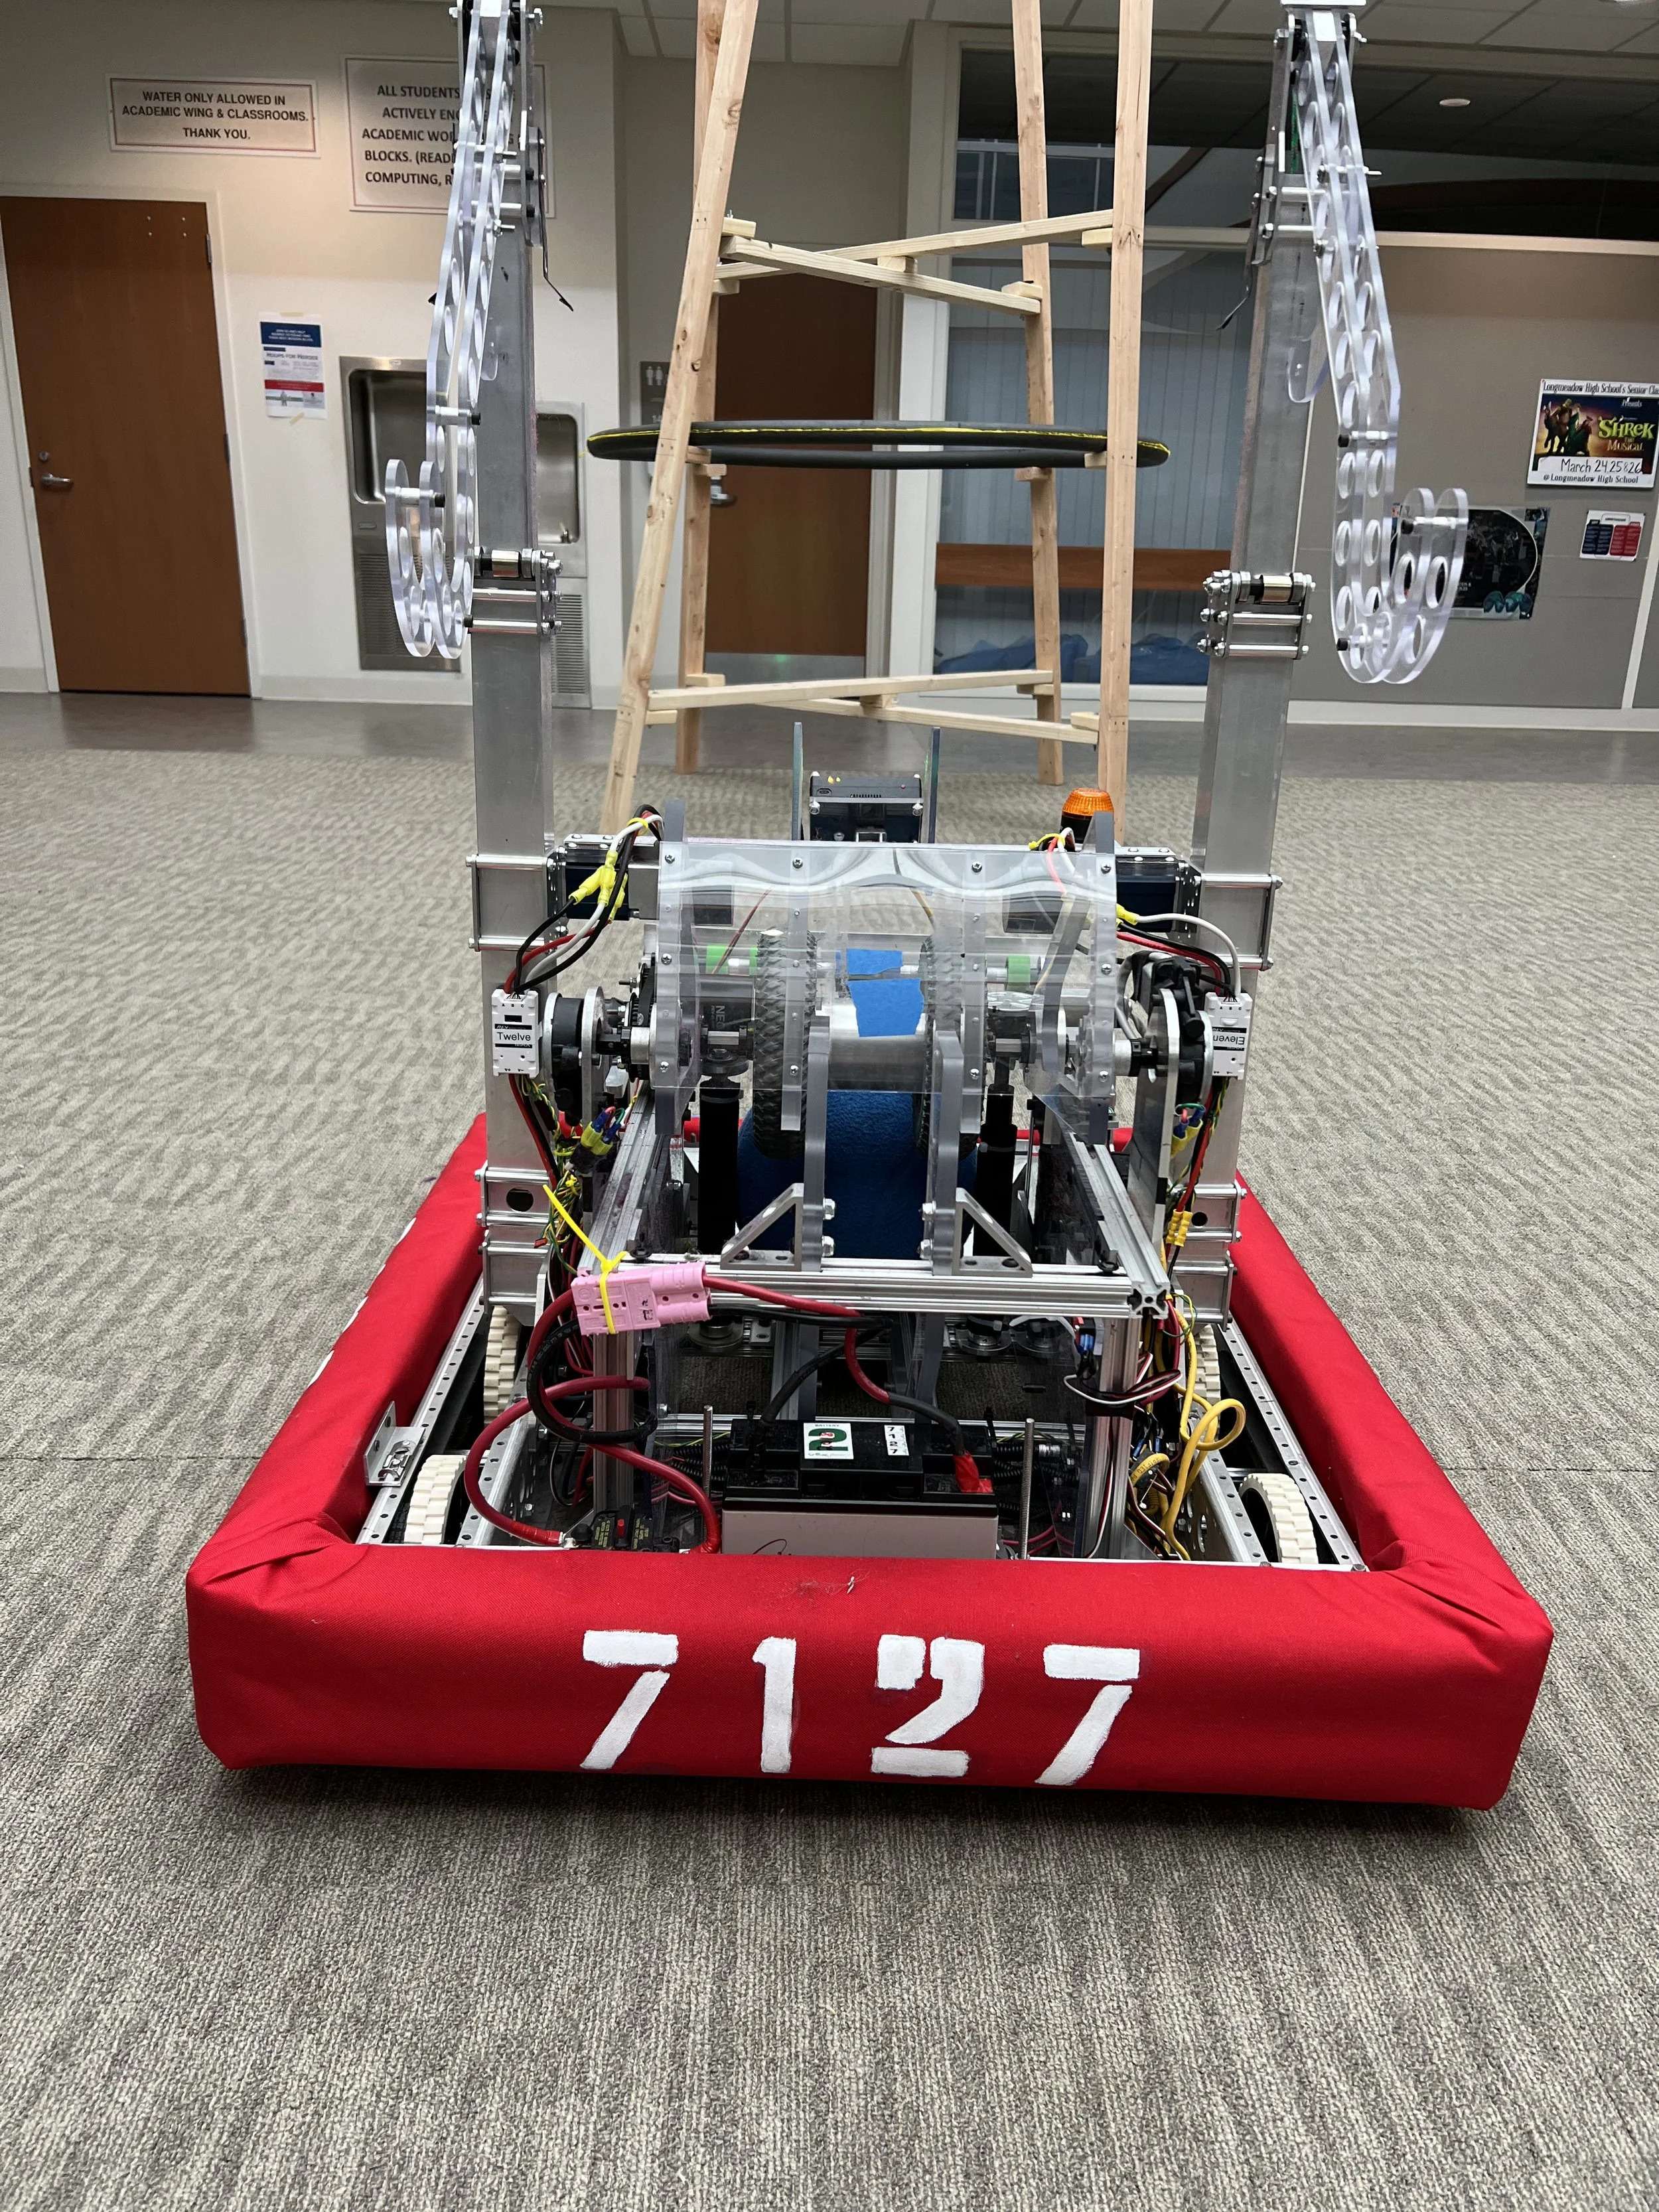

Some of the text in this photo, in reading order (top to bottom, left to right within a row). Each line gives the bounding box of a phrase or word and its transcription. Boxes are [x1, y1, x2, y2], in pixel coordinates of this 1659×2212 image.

[143, 90, 285, 106] WATER ONLY ALLOWED IN
[378, 84, 459, 99] ALL STUDENTS
[122, 106, 309, 122] ACADEMIC WING & CLASSROOMS.
[382, 107, 437, 120] ACTIVELY
[183, 127, 251, 140] THANK YOU.
[362, 127, 424, 141] ACADEMIC
[365, 150, 412, 163] BLOCKS.
[366, 171, 441, 186] COMPUTING,
[1544, 382, 1583, 394] Longmeadow
[1585, 383, 1599, 396] High
[1601, 384, 1625, 394] School's
[1627, 384, 1647, 394] Senior
[1561, 459, 1591, 473] March
[1551, 474, 1595, 482] Longmeadow
[1597, 475, 1613, 484] High
[496, 1032, 531, 1041] Twelve
[1213, 1035, 1245, 1045] Eleven
[808, 1428, 849, 1451] 2
